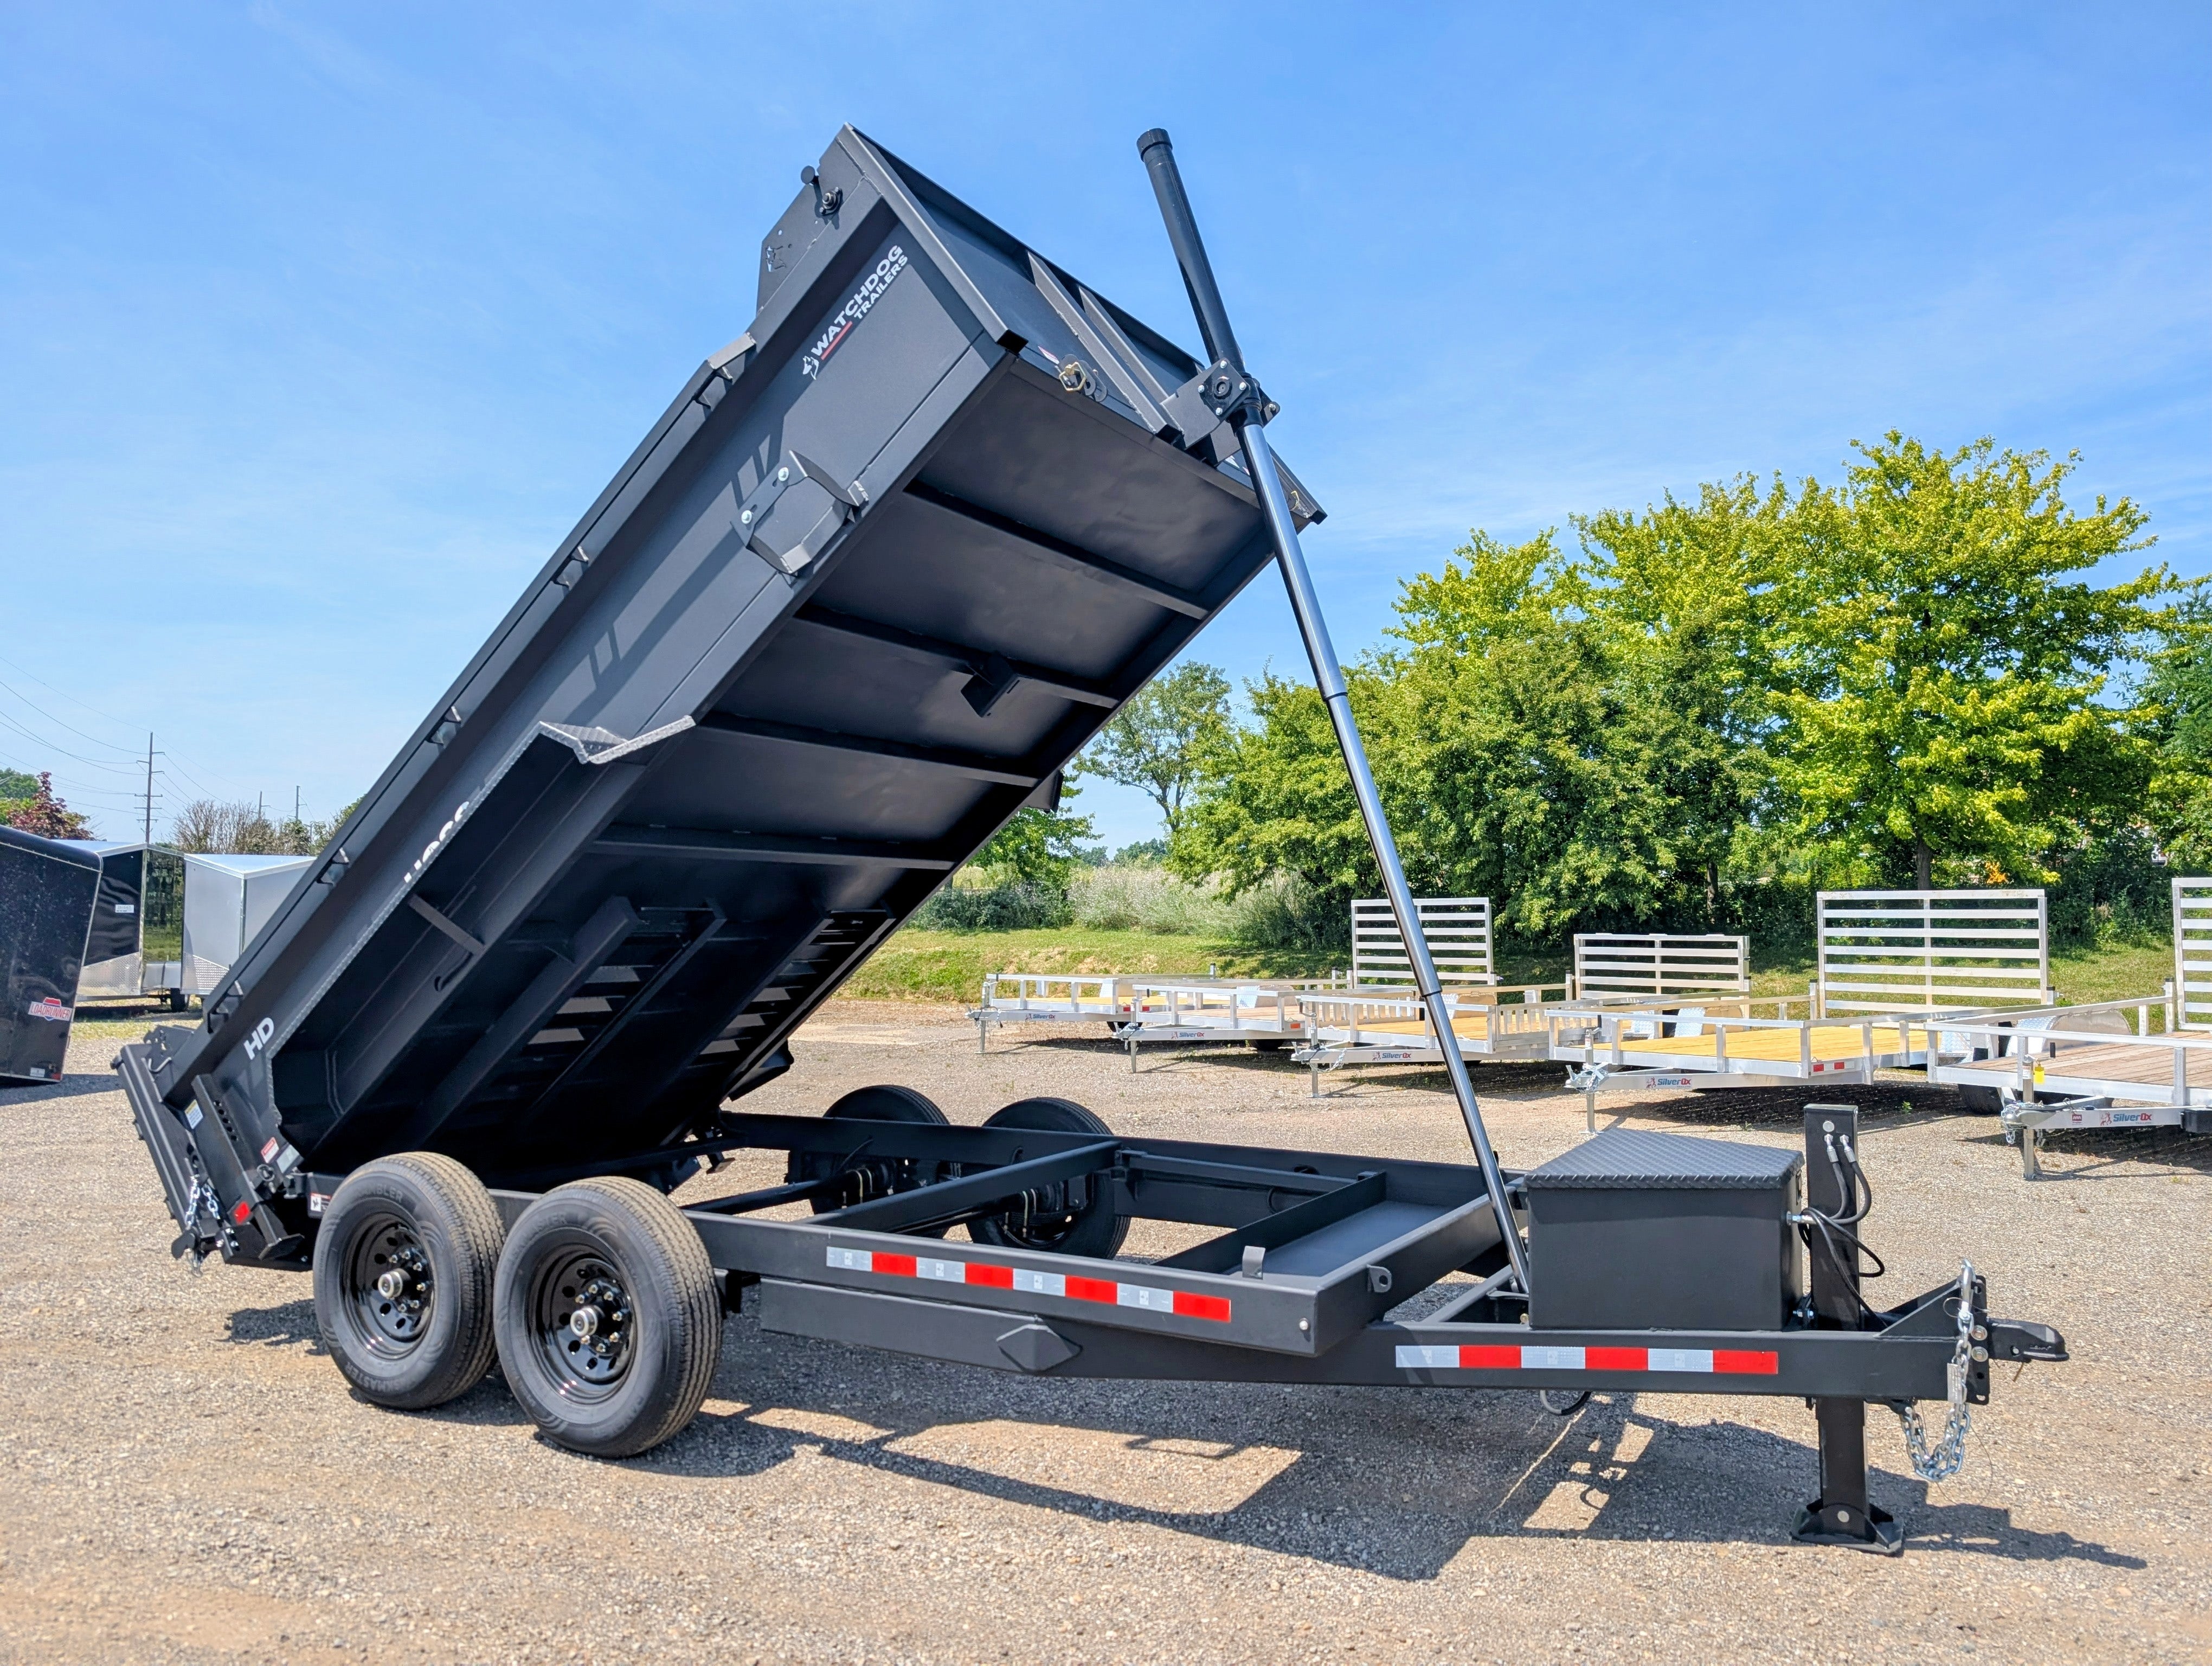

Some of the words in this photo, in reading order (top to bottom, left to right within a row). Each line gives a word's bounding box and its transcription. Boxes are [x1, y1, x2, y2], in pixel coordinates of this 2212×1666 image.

[811, 245, 903, 356] WATCHDOG
[854, 254, 908, 319] TRAILERS
[30, 1003, 70, 1019] LOADRUNNER
[243, 1017, 274, 1060] HD
[2113, 1112, 2152, 1122] SilverOx
